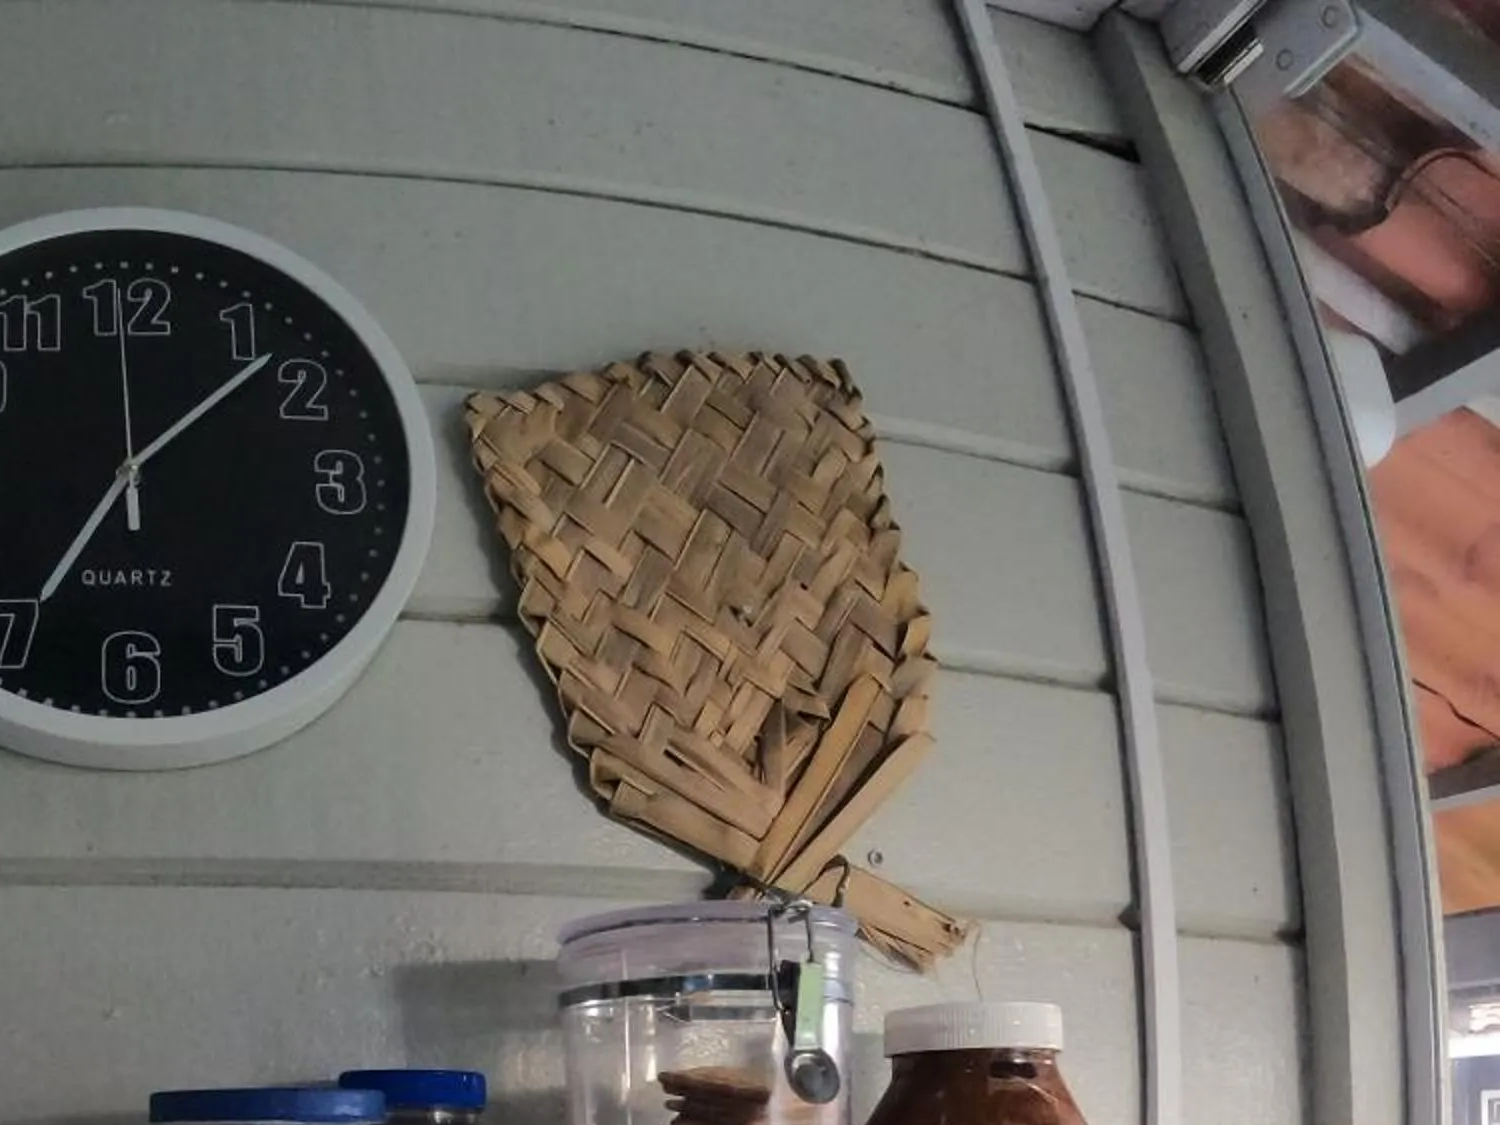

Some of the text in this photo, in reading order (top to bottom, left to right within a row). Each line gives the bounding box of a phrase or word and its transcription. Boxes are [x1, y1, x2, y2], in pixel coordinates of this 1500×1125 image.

[82, 278, 171, 335] 12
[219, 303, 256, 360] 1
[277, 359, 329, 420] 2
[314, 450, 366, 514] 3
[81, 569, 172, 587] QUARTZ
[277, 541, 331, 608] 4
[101, 631, 161, 704] 6
[212, 605, 264, 676] 5
